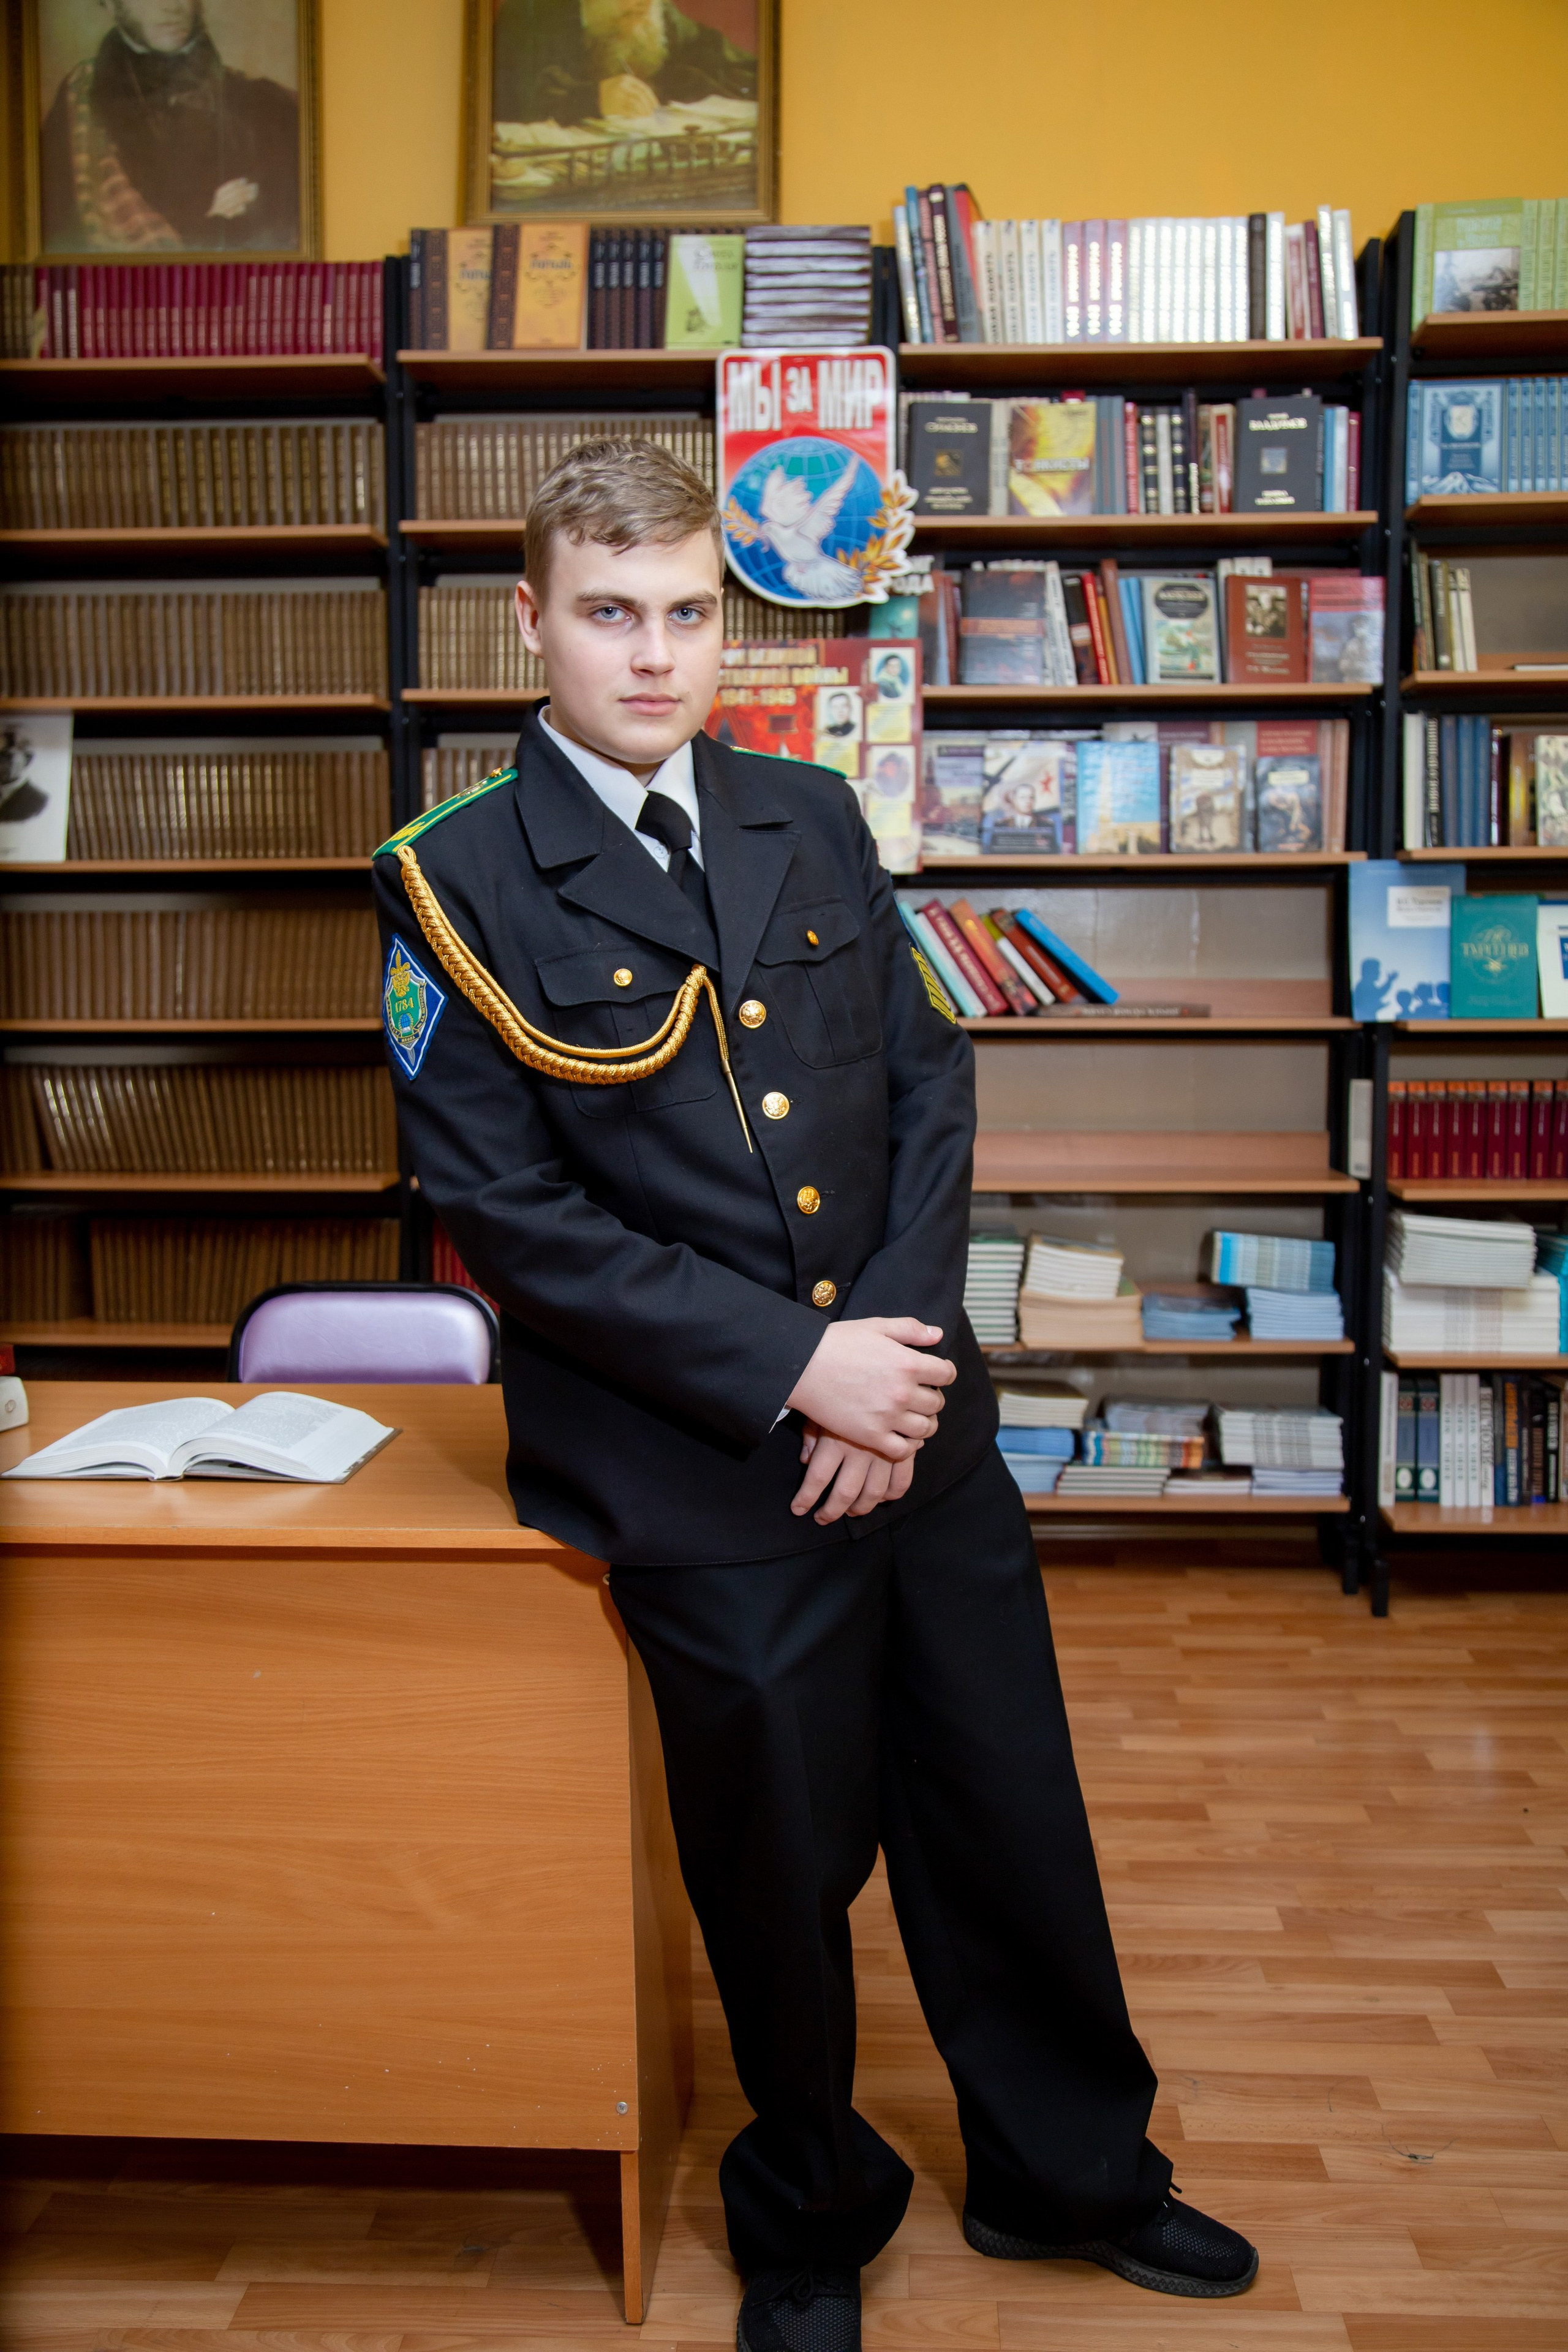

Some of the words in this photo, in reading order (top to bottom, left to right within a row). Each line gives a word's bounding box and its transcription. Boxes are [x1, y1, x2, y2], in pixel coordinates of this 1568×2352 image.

[727, 359, 781, 431] МЫ
[786, 366, 813, 413] ЗА
[817, 359, 885, 429] МИР
[394, 997, 415, 1013] 1784
